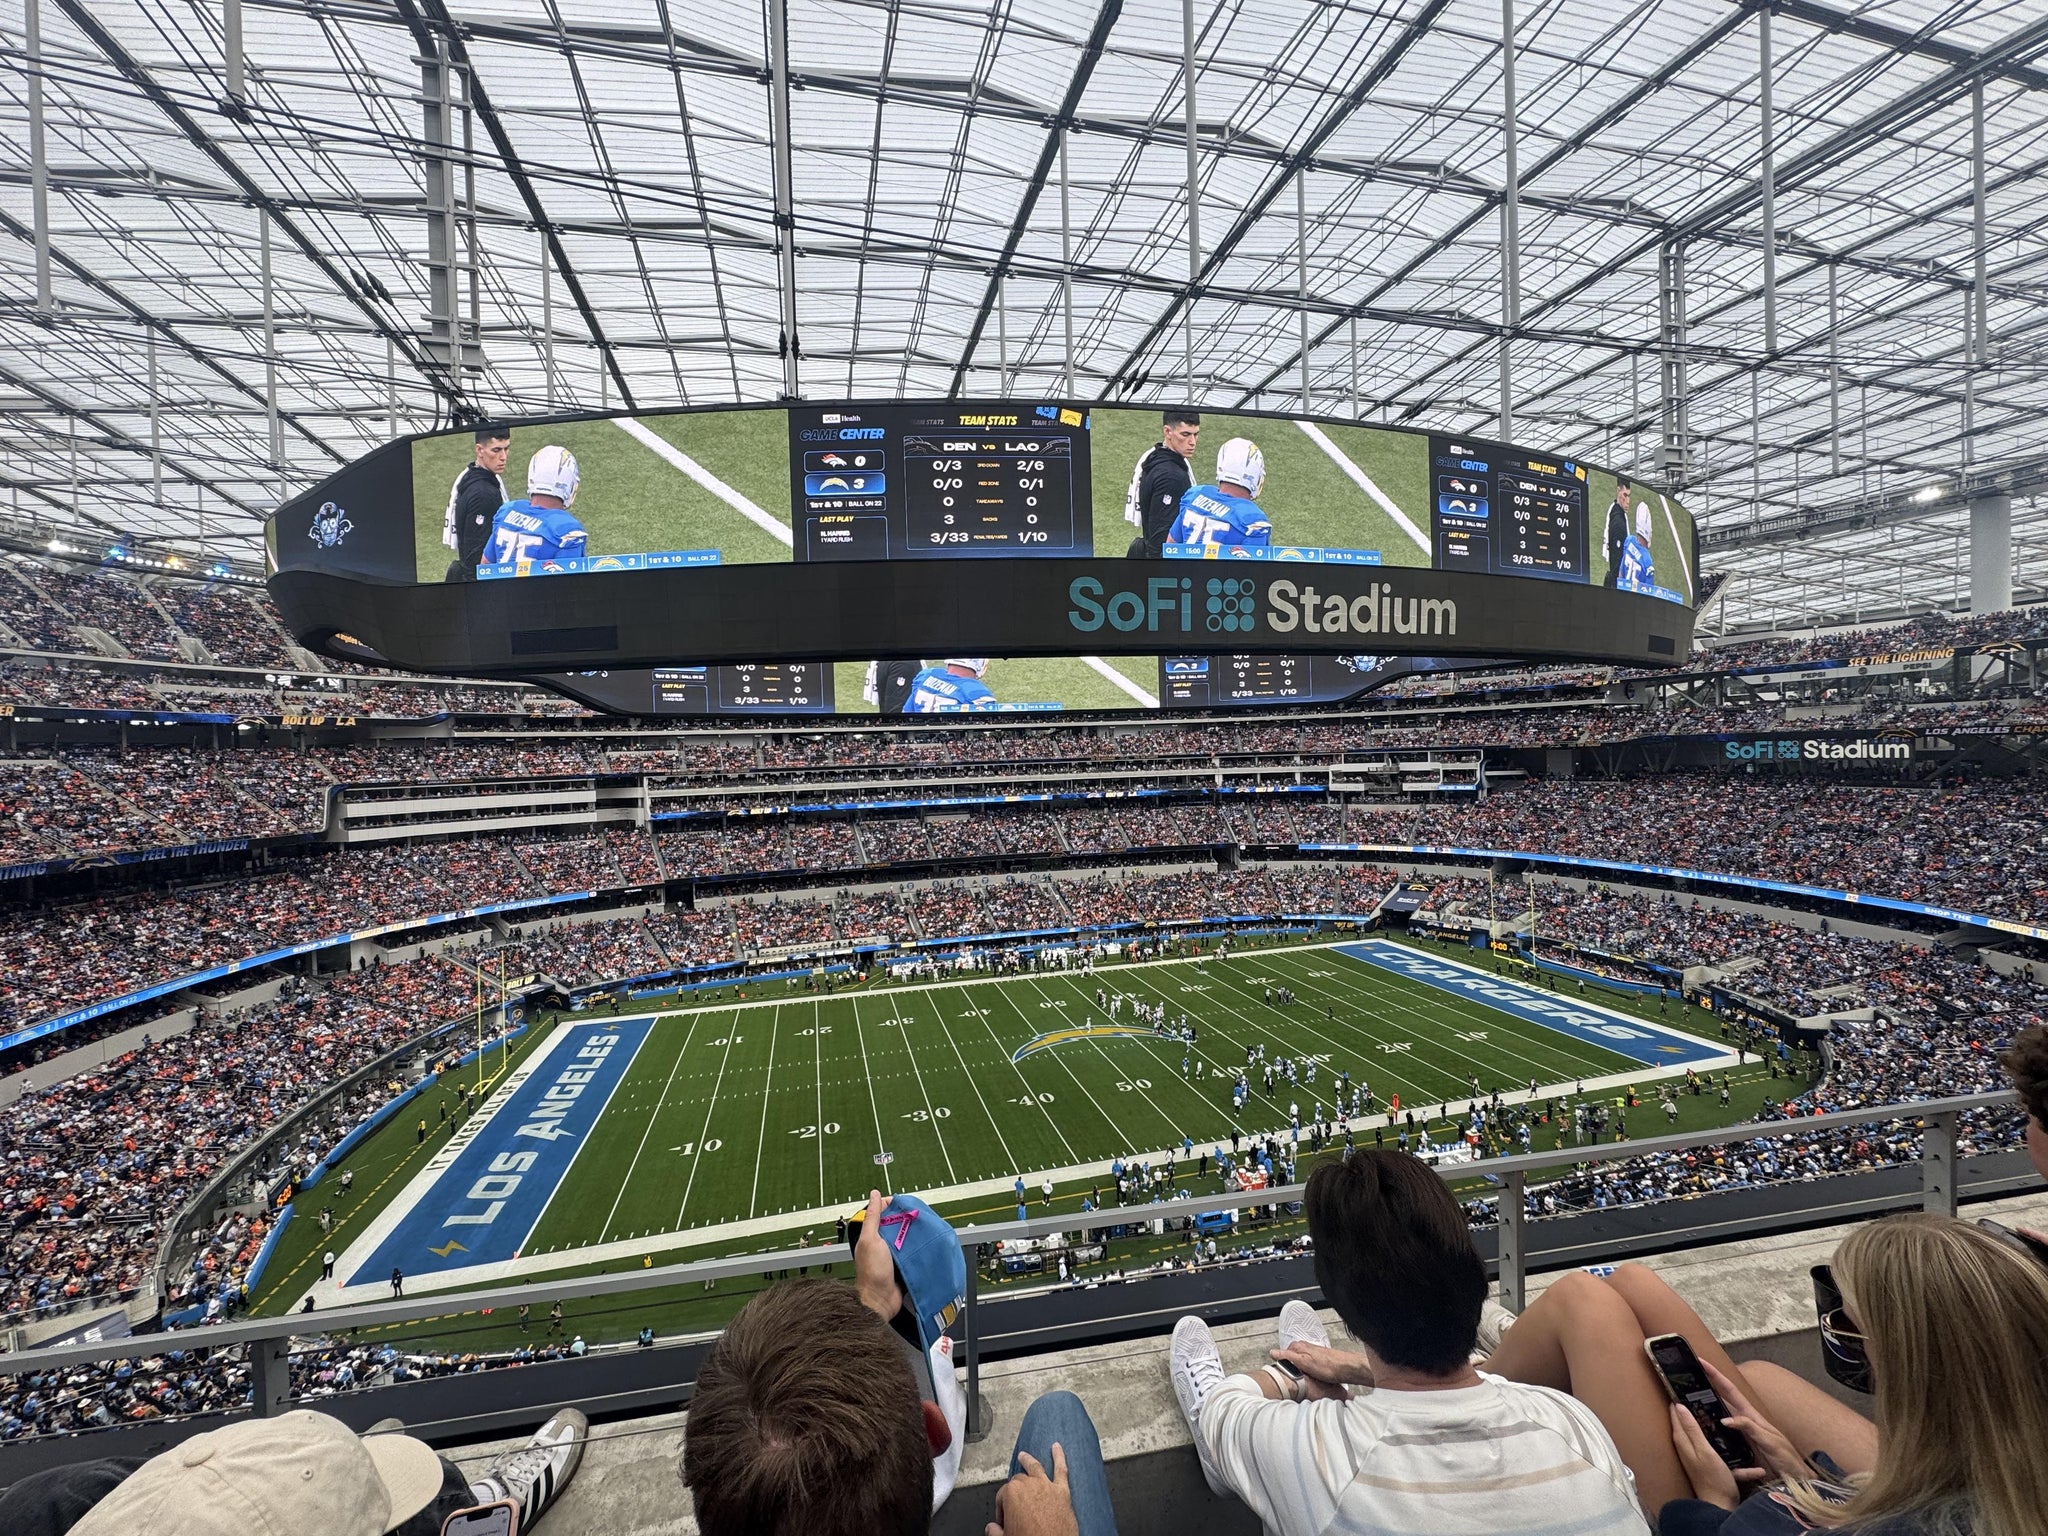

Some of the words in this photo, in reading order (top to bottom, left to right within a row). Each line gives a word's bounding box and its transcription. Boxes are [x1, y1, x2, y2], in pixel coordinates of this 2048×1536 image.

[959, 416, 986, 426] TEAM
[987, 415, 1017, 425] STATS
[800, 429, 838, 441] GAME
[839, 428, 885, 440] CENTER
[943, 442, 976, 451] DEN
[854, 455, 866, 467] 0
[932, 460, 962, 472] 0/3
[1017, 460, 1044, 472] 2/6
[1460, 460, 1488, 473] CENTER
[1528, 461, 1541, 471] TEAM
[1541, 464, 1557, 475] STATS
[853, 478, 865, 489] 3
[933, 479, 963, 490] 0/0
[1019, 479, 1044, 490] 0/1
[1470, 484, 1478, 493] 0
[1519, 482, 1537, 492] DEN
[943, 497, 954, 507] 0
[1026, 497, 1037, 507] 0
[1469, 503, 1477, 512] 3
[1514, 495, 1530, 506] 0/3
[1556, 503, 1569, 513] 2/6
[944, 515, 954, 525] 3
[1027, 514, 1038, 524] 0
[1514, 511, 1530, 521] 0/0
[1557, 518, 1569, 527] 0/1
[1182, 509, 1231, 544] 75
[1520, 526, 1526, 534] 0
[1560, 532, 1566, 540] 0
[930, 533, 969, 544] 3/33
[1018, 532, 1048, 544] 1/10
[496, 527, 543, 563] 75
[1520, 541, 1526, 549] 3
[1561, 547, 1566, 555] 0
[1256, 549, 1263, 557] 0
[1308, 551, 1315, 559] 3
[569, 561, 577, 569] 0
[628, 558, 636, 566] 3
[1512, 555, 1534, 565] 3/33
[1556, 560, 1571, 569] 1/10
[1068, 576, 1191, 632] SoFi
[1267, 579, 1457, 635] Stadium
[1848, 656, 1866, 667] SEE
[1870, 654, 1889, 665] THE
[1892, 649, 1954, 664] LIGHTNING
[1903, 662, 1932, 670] PEPSI
[1801, 672, 1826, 680] PEPSI
[735, 697, 760, 705] 3/33
[789, 697, 808, 705] 1/10
[282, 715, 308, 726] BOLT
[310, 716, 325, 726] UP
[336, 716, 356, 726] LA
[1952, 726, 2010, 736] ANGELES
[1725, 741, 1773, 760] SoFi
[1803, 739, 1910, 759] Stadium
[141, 851, 167, 862] FEEL
[171, 848, 189, 858] THE
[193, 840, 248, 855] THUNDER
[1924, 907, 1948, 918] SHOP
[1952, 911, 1972, 922] THE
[292, 943, 317, 954] SHOP
[319, 938, 338, 949] THE
[506, 978, 523, 989] BOLT
[525, 976, 535, 984] UP
[1373, 951, 1655, 1040] CHARGERS
[64, 1017, 78, 1026] 1ST
[79, 1014, 86, 1022] &
[88, 1008, 98, 1019] 10
[102, 1003, 118, 1014] BALL
[119, 1000, 127, 1009] ON
[1454, 1031, 1488, 1042] 10
[1376, 1042, 1411, 1054] 20
[1211, 1066, 1245, 1078] 40
[1115, 1079, 1153, 1092] 50
[1018, 1092, 1055, 1107] 40
[912, 1107, 951, 1122] 30
[426, 1159, 450, 1171] IT
[443, 1120, 486, 1154] TAKES
[477, 1099, 503, 1116] ALL
[497, 1086, 513, 1097] OF
[510, 1072, 530, 1083] US
[441, 1151, 539, 1228] LOS
[513, 1034, 620, 1142] ANGELES
[800, 1122, 841, 1139] 20
[680, 1138, 722, 1156] 10
